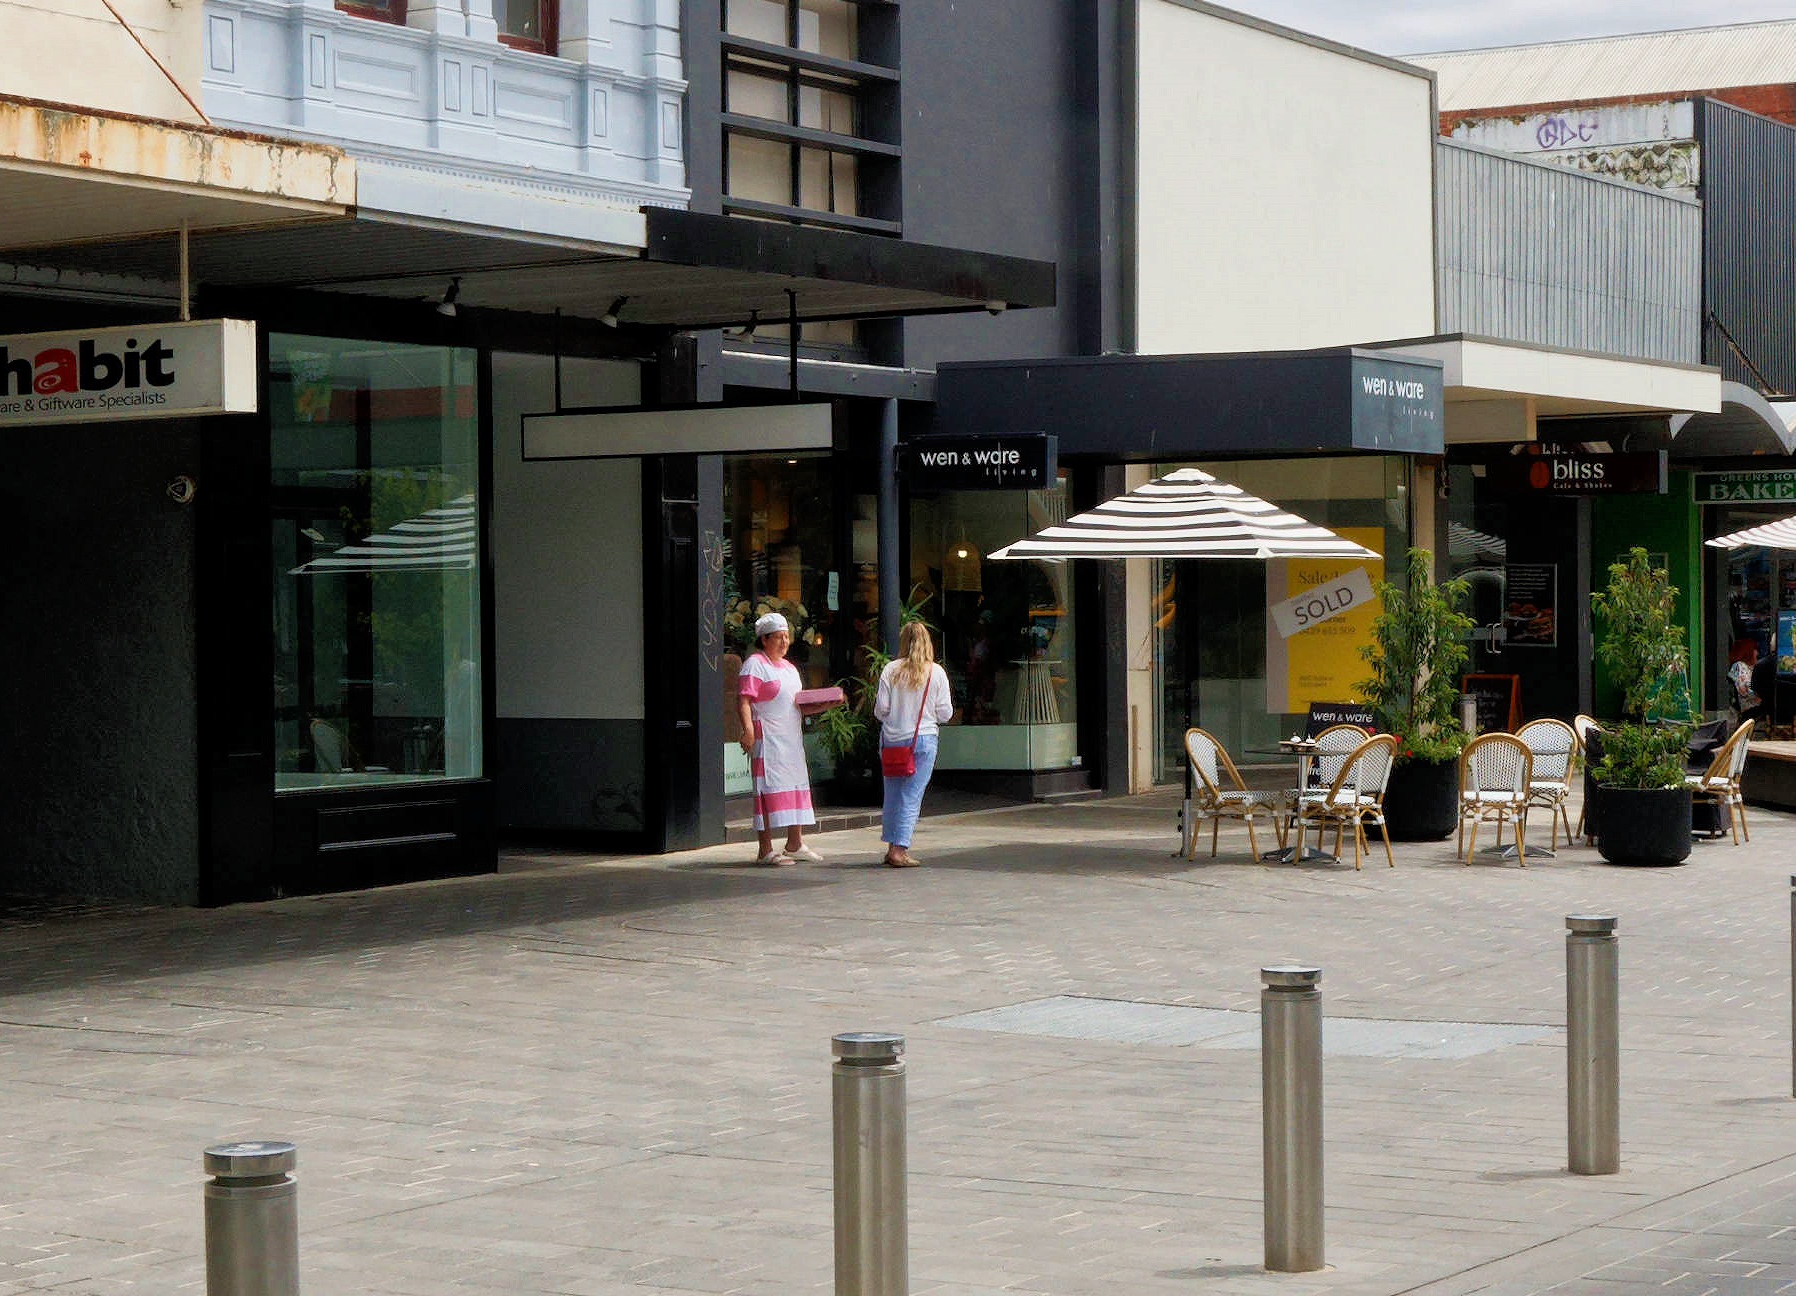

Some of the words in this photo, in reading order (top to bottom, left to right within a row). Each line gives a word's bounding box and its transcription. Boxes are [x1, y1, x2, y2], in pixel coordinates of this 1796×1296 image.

[1363, 376, 1387, 396] wen
[1388, 380, 1395, 396] &
[1396, 379, 1424, 400] ware
[24, 399, 35, 412] &
[38, 395, 96, 412] Giftware
[98, 391, 166, 408] Specialists
[920, 450, 958, 466] wen
[961, 452, 972, 465] &
[973, 449, 1021, 465] ware
[1553, 459, 1605, 480] bliss
[1295, 587, 1353, 626] SOLD
[1312, 711, 1337, 722] wen
[1345, 712, 1374, 723] ware
